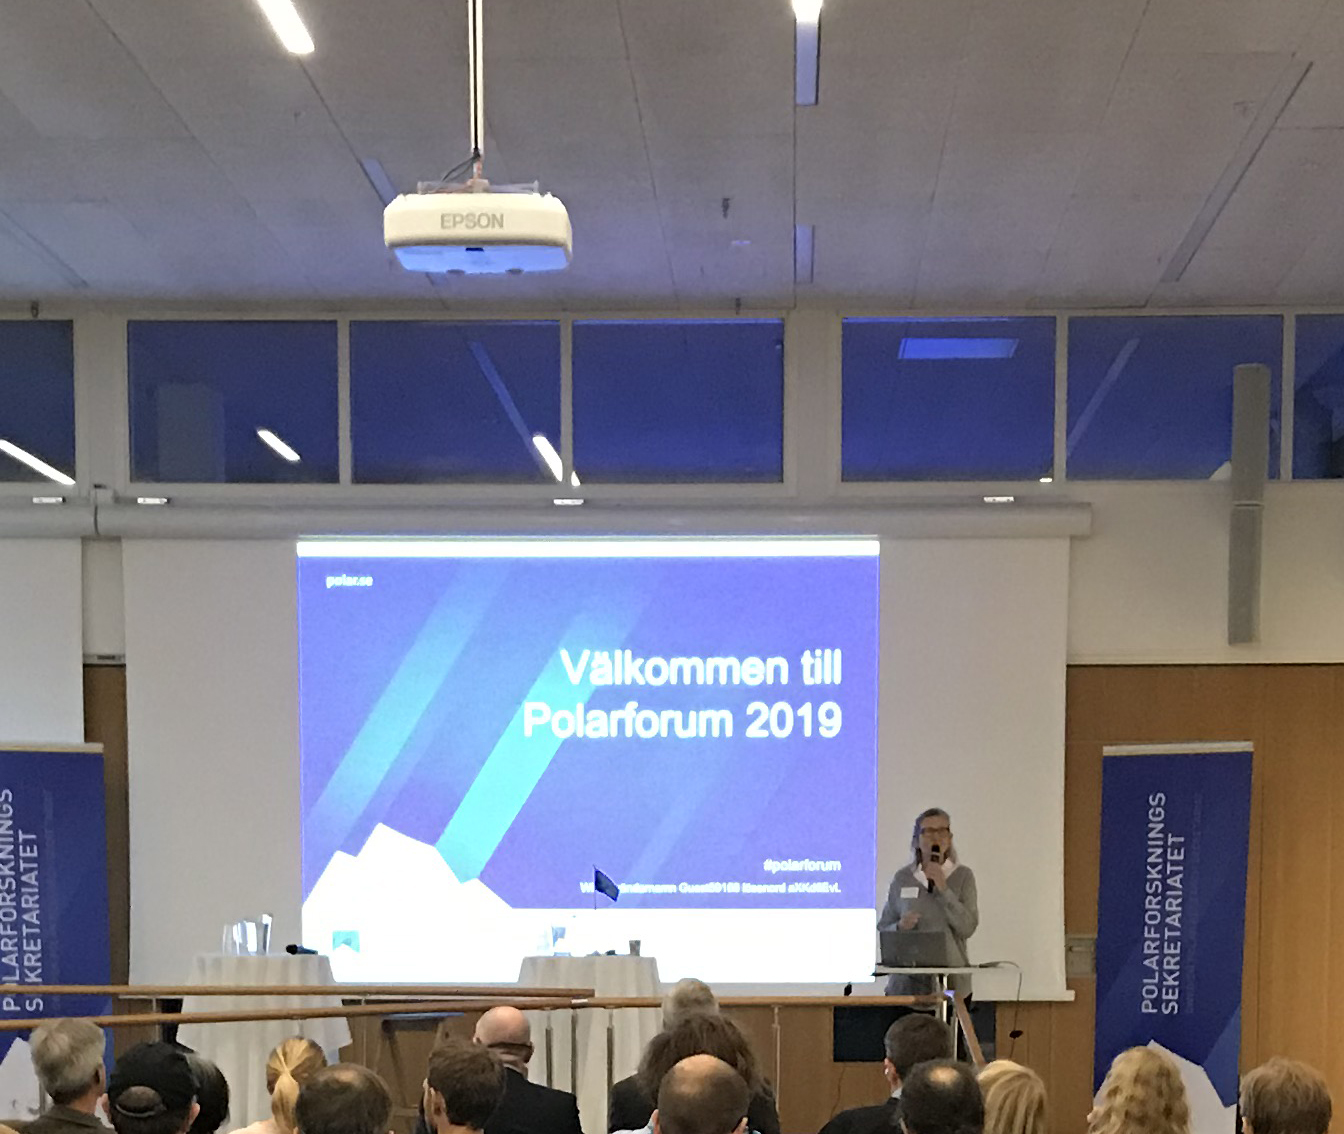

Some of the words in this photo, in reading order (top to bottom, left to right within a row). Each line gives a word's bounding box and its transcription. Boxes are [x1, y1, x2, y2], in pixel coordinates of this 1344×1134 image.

[441, 213, 504, 229] EPSON
[523, 702, 733, 738] Polarforum
[746, 702, 842, 738] 2019
[560, 649, 789, 685] Välkommen
[801, 649, 842, 685] till
[18, 831, 44, 1012] SKRETARIATET
[1141, 792, 1166, 1014] POLARFORSKNINGS
[1162, 833, 1185, 1015] SEKRETARIATET
